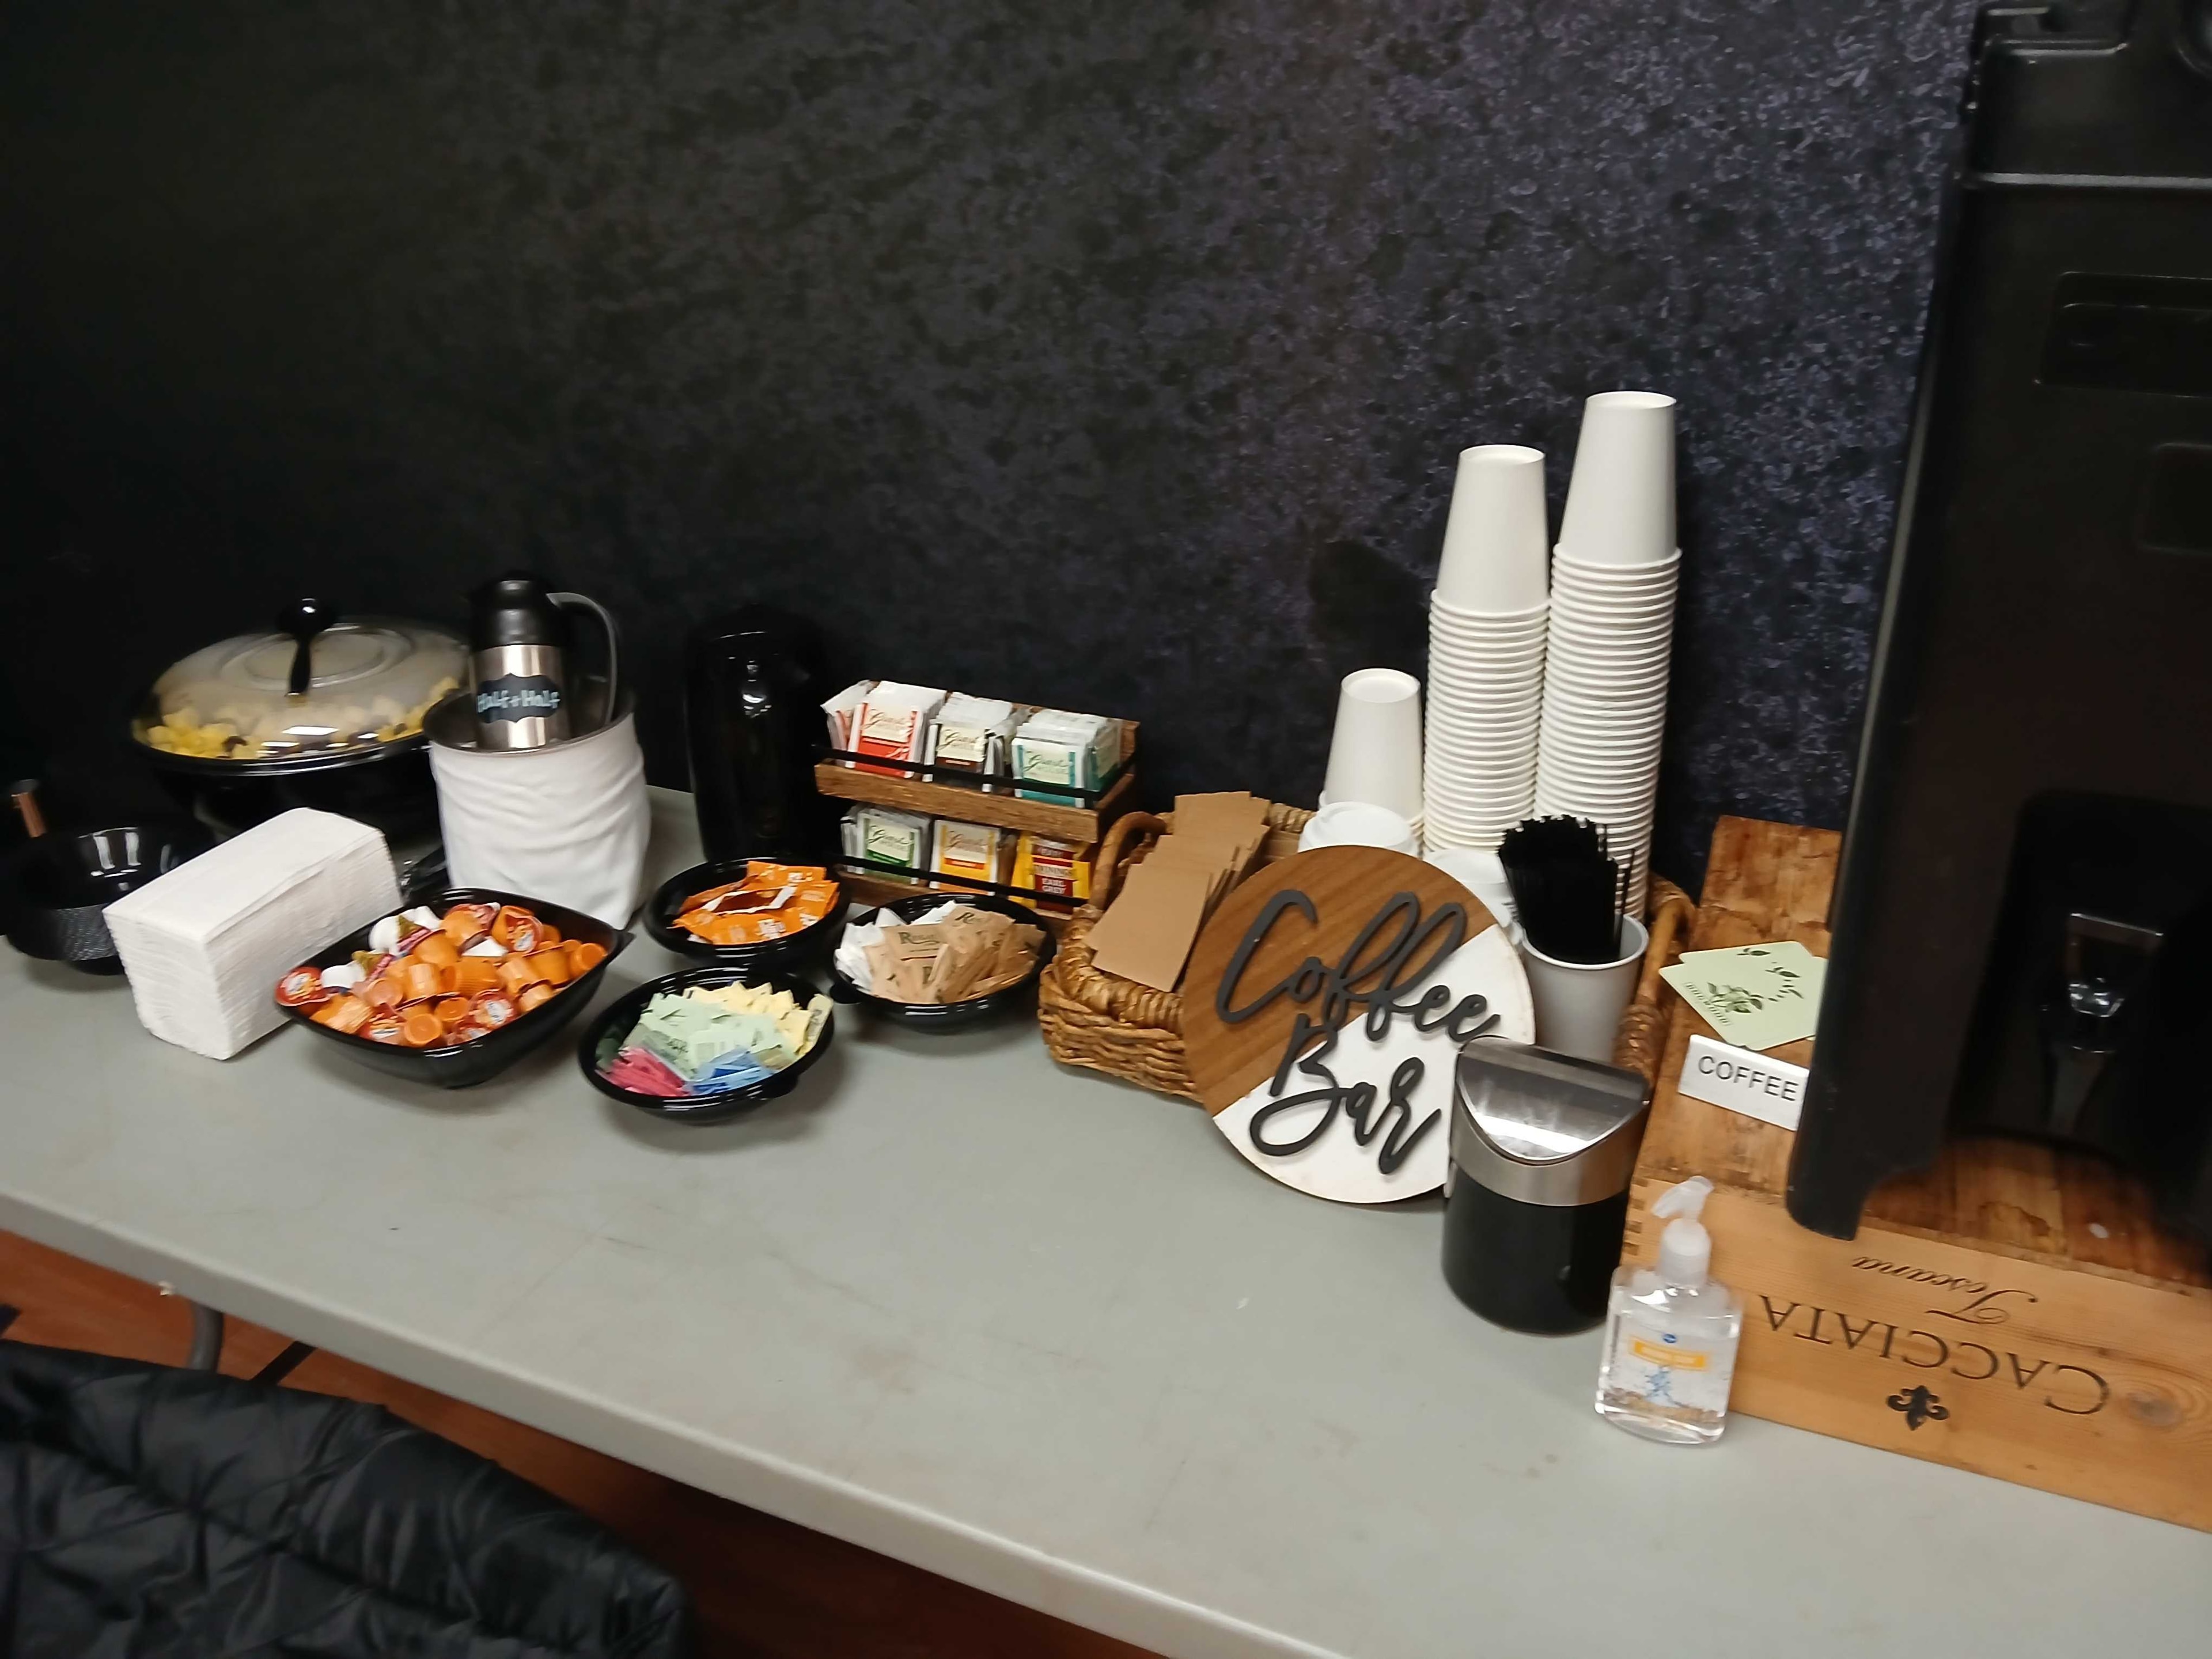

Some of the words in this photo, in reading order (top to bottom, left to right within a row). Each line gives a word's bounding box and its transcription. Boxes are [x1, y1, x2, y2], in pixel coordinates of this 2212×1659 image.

[1216, 889, 1500, 1041] Coffee
[1249, 1013, 1441, 1175] Bar
[1698, 1055, 1800, 1102] COFFEE
[1851, 1255, 2039, 1325] Toscana
[1758, 1294, 2111, 1416] CACCIATA
